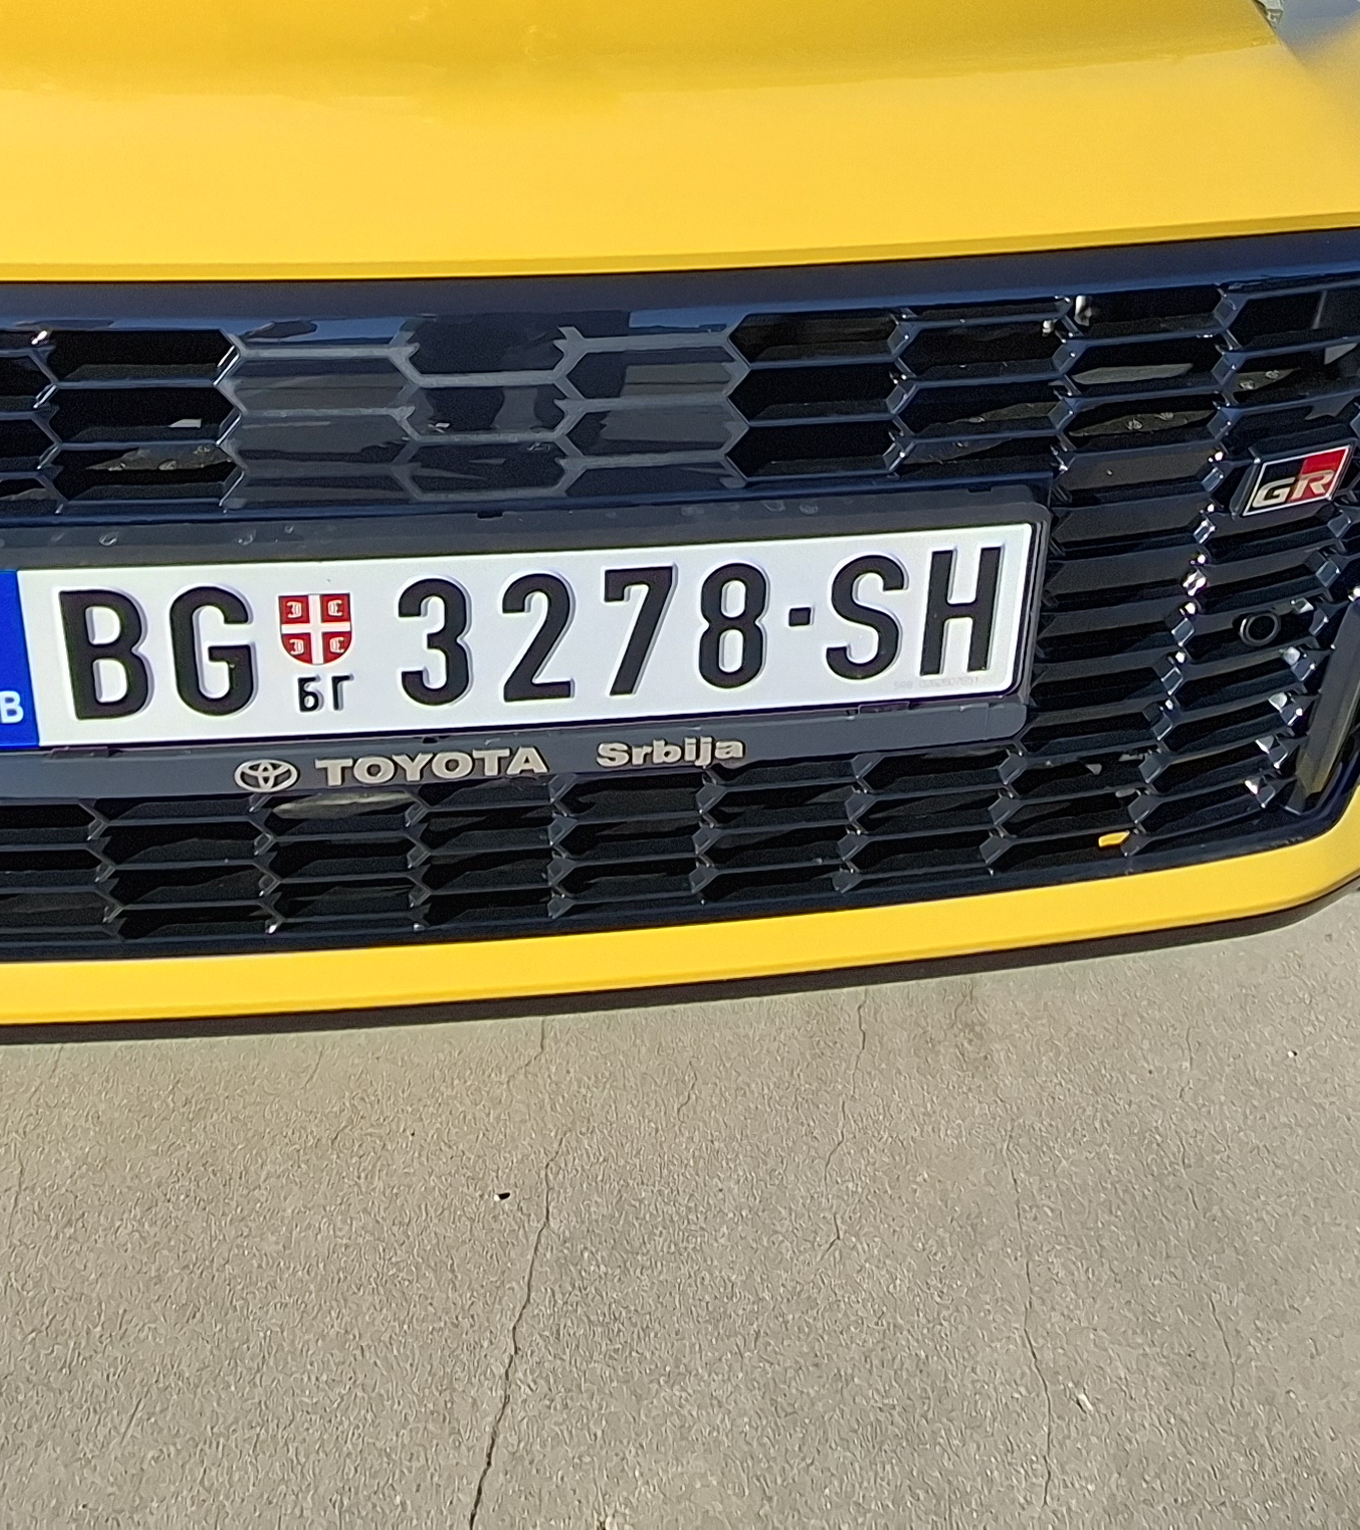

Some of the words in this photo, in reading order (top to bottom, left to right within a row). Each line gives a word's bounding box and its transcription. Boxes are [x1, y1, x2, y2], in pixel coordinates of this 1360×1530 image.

[1251, 469, 1335, 508] GR
[58, 584, 257, 721] BG
[315, 746, 549, 786] TOYOTA
[596, 736, 746, 768] Srbija
